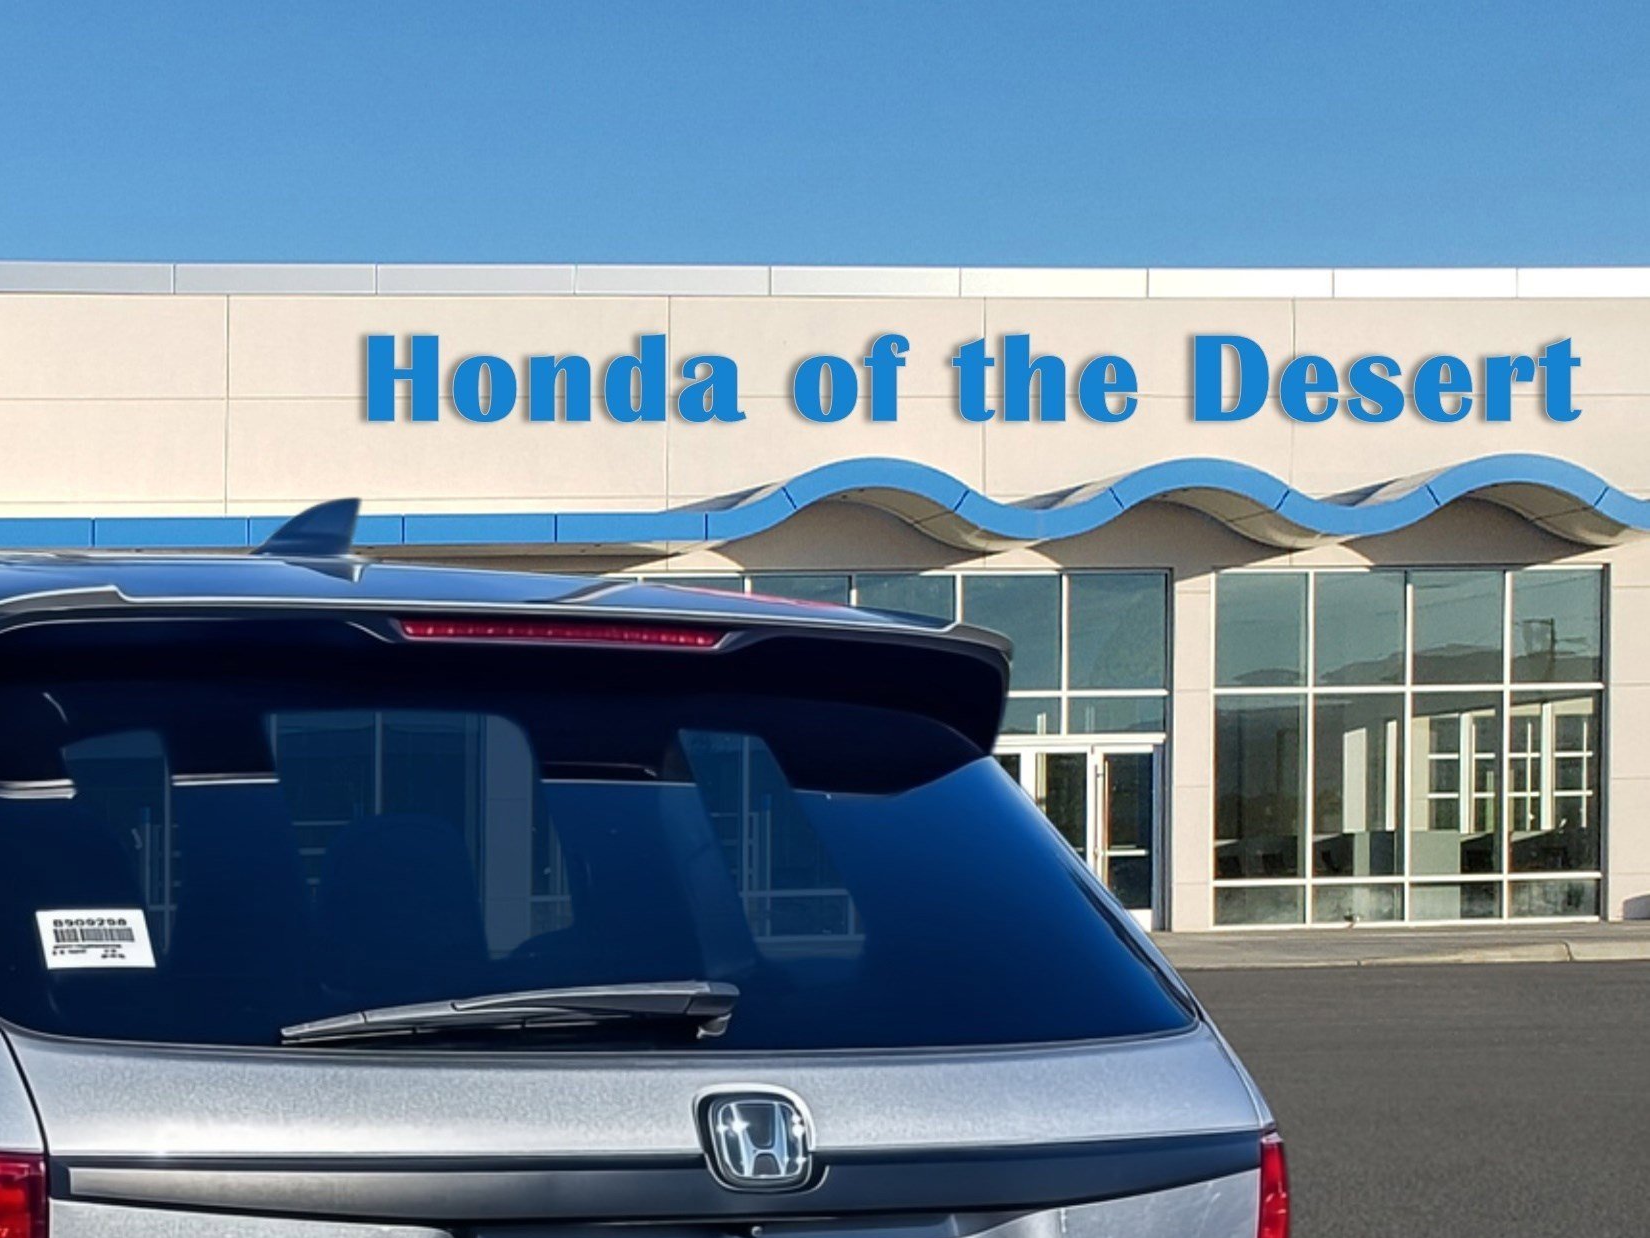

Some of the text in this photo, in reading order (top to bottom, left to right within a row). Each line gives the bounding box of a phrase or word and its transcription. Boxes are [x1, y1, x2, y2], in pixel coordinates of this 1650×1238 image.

[364, 332, 1583, 424] Honda of the Desert
